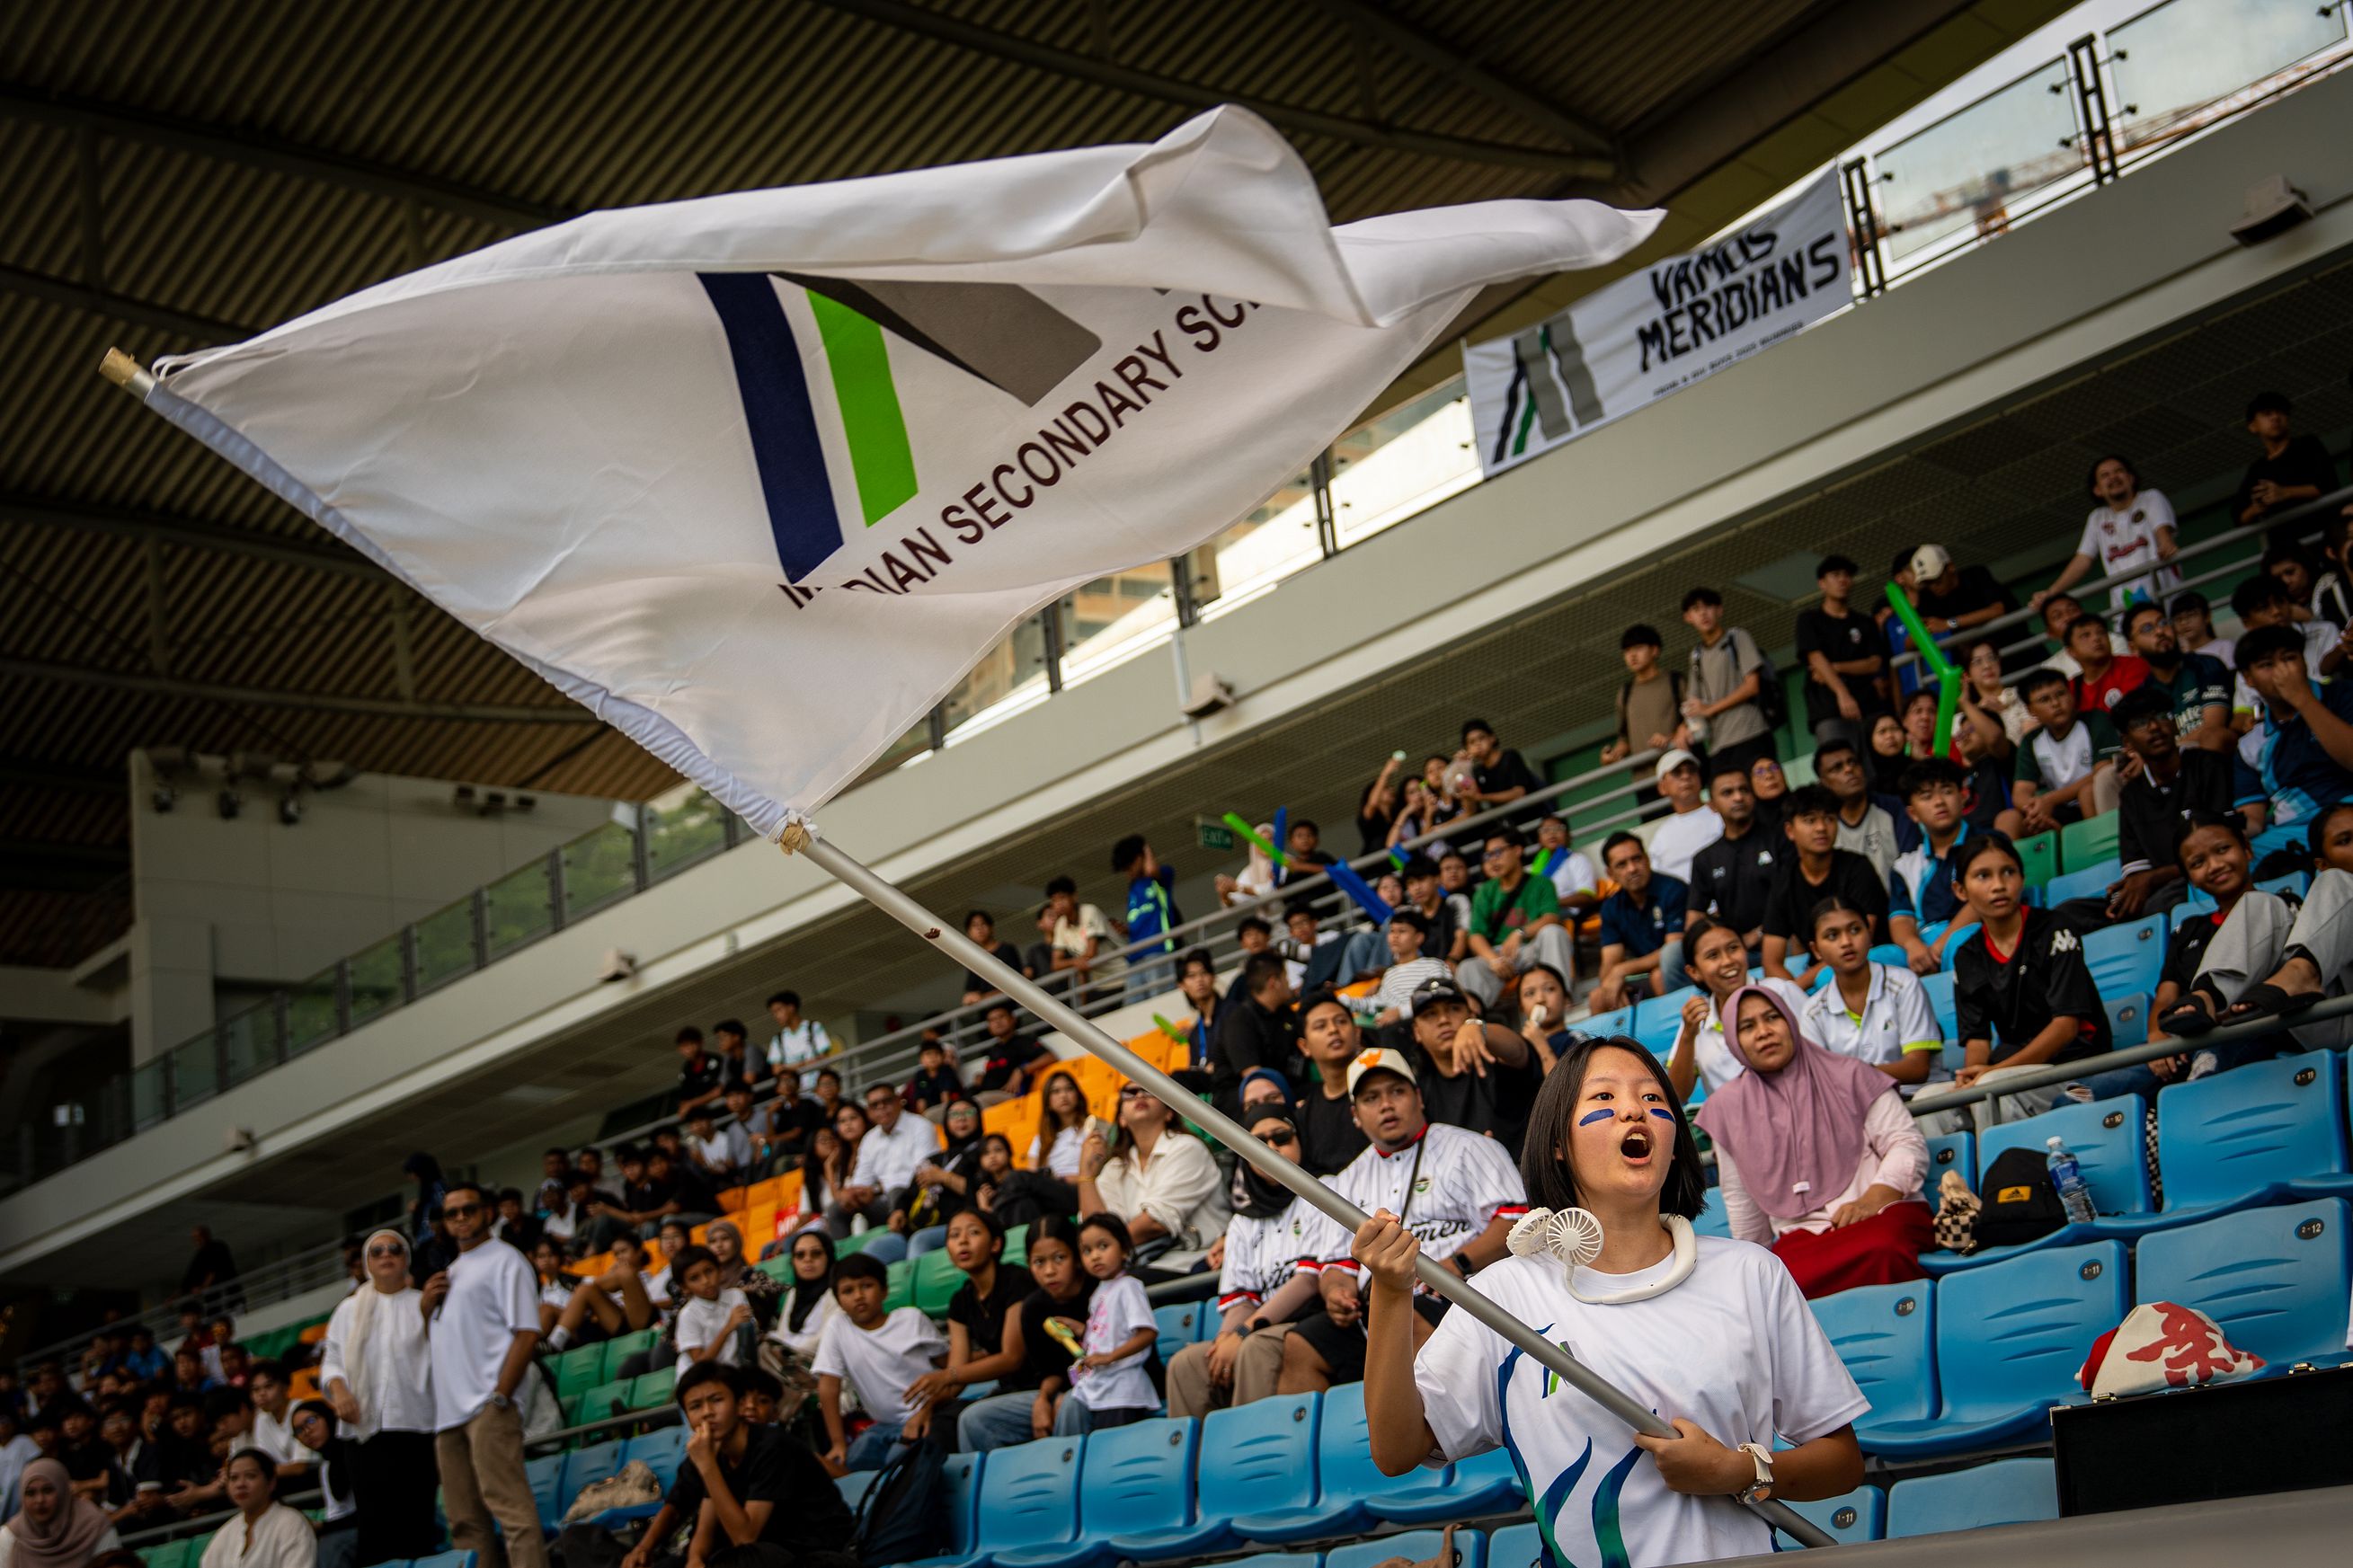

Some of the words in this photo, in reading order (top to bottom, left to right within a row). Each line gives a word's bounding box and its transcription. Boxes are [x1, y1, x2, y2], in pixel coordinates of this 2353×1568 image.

[1651, 227, 1779, 311] VAMOS
[1637, 231, 1840, 373] MERIDIANS
[941, 329, 1183, 545] SECONDARY
[2301, 1223, 2322, 1234] 2-12
[2083, 1264, 2100, 1275] 2-11
[1836, 1512, 1854, 1523] 1-11
